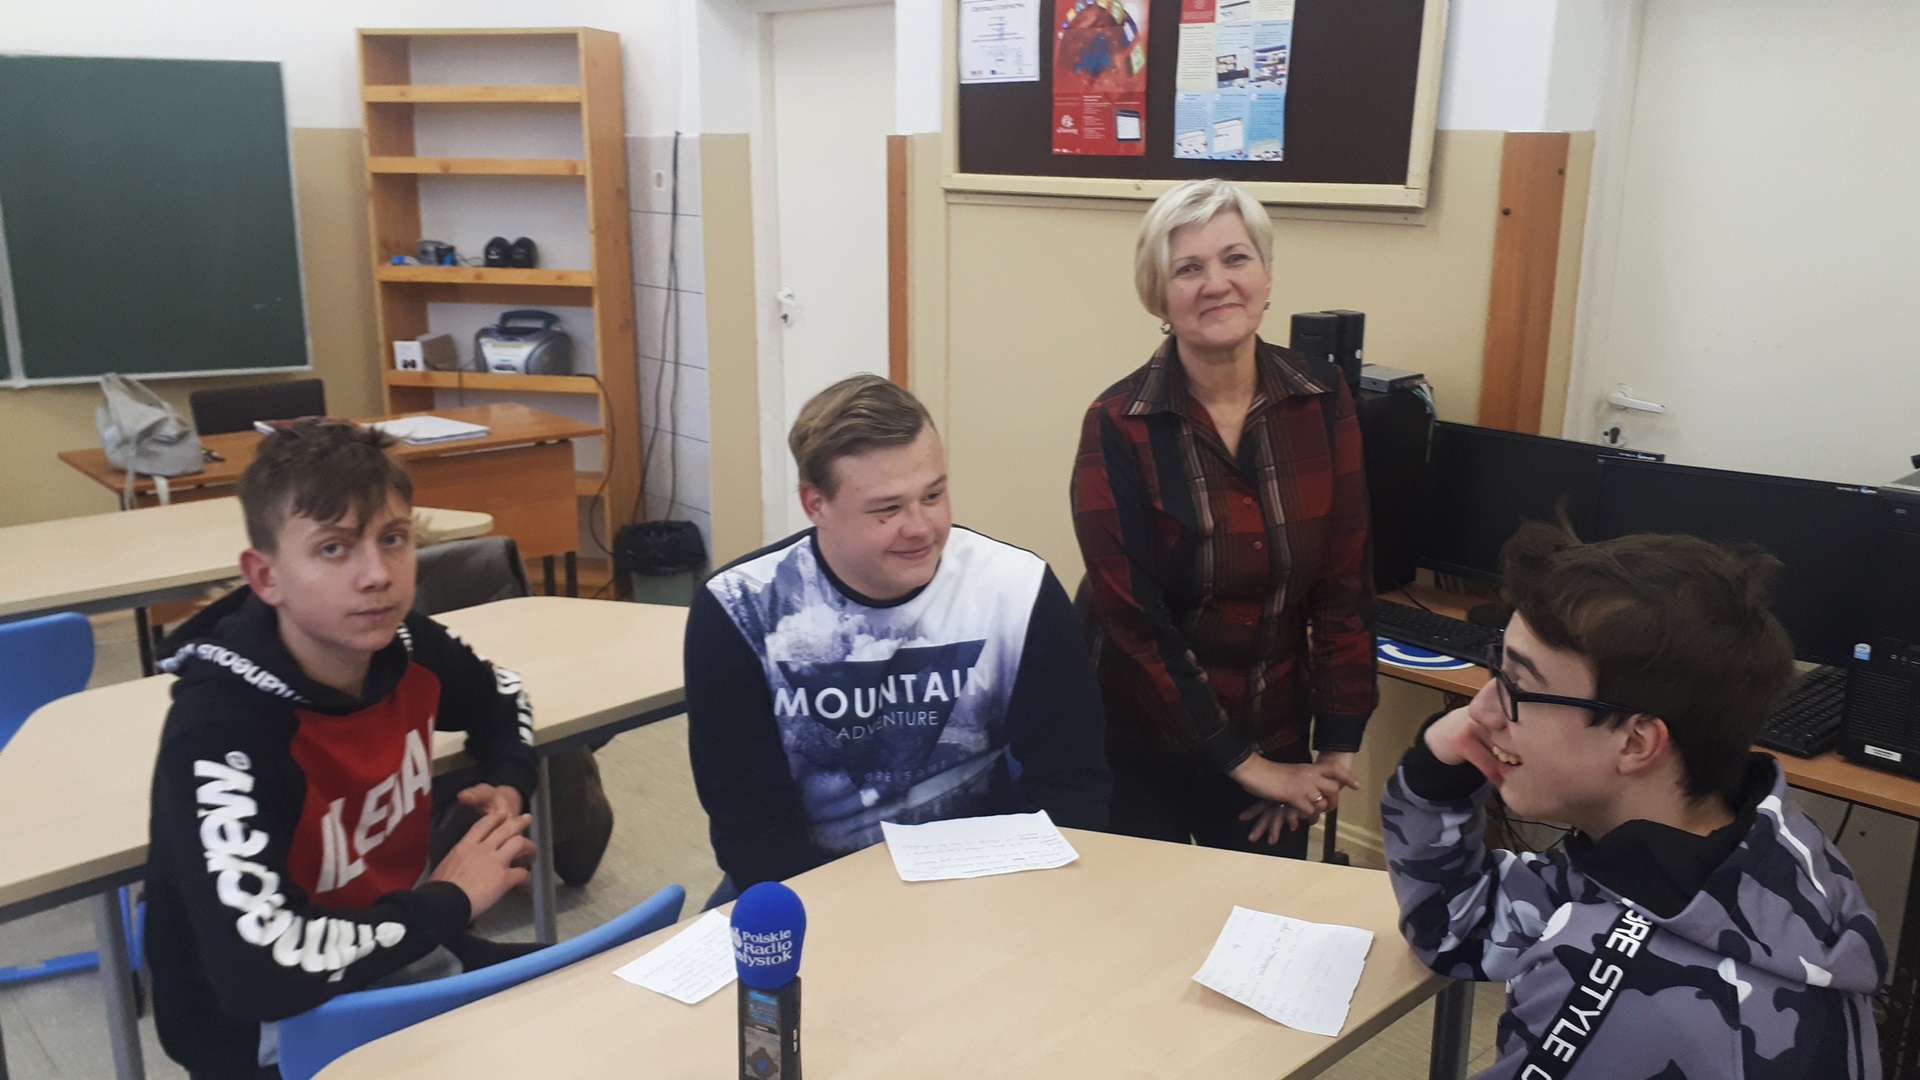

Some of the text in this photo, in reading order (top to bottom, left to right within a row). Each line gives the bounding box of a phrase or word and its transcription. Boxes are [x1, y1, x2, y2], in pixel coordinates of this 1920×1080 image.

[774, 666, 989, 719] MOUNTAIN
[836, 711, 939, 740] ADVENTURE
[742, 929, 792, 943] Polskie
[743, 941, 793, 955] Radio
[1542, 958, 1624, 1063] STYLE
